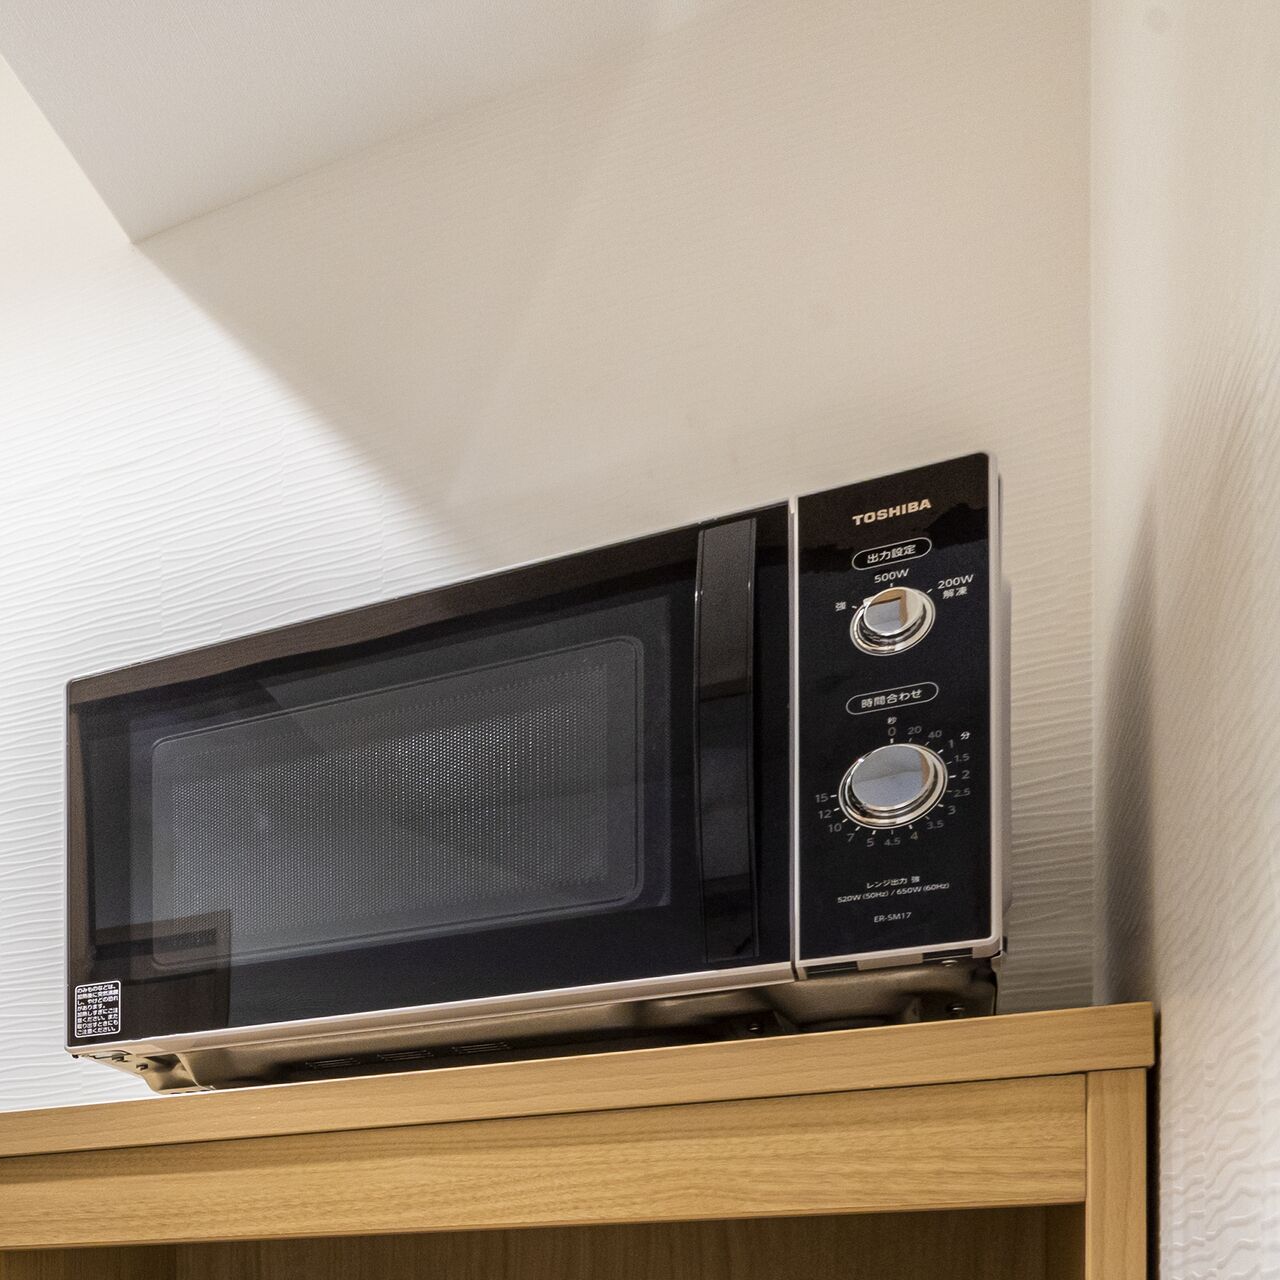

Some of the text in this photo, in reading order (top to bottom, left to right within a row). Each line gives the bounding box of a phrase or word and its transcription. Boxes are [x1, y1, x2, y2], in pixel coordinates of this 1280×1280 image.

[852, 498, 932, 526] TOSHIBA
[867, 544, 916, 564] 出力設定
[874, 568, 910, 583] 500W
[938, 574, 974, 589] 200W
[942, 586, 968, 599] 解凍
[861, 688, 922, 708] 時間合わせ
[888, 726, 942, 738] 0 20 40
[960, 732, 971, 740] 分
[949, 740, 954, 748] 1
[954, 753, 970, 762] 1.5
[962, 770, 970, 779] 2
[954, 788, 971, 798] 2.5
[816, 794, 828, 803] 15
[818, 810, 832, 819] 12
[948, 805, 956, 815] 3
[828, 824, 842, 832] 10
[927, 821, 944, 830] 3.5
[847, 833, 855, 842] 7
[910, 832, 918, 840] 4
[867, 838, 874, 847] 5
[884, 838, 901, 846] 4.5
[866, 878, 908, 888] レンジ出力
[837, 894, 862, 903] 520W
[862, 891, 888, 900] (50Hz)
[896, 886, 922, 895] 650W
[922, 882, 950, 891] (60Hz)
[874, 912, 912, 922] ER-SM17
